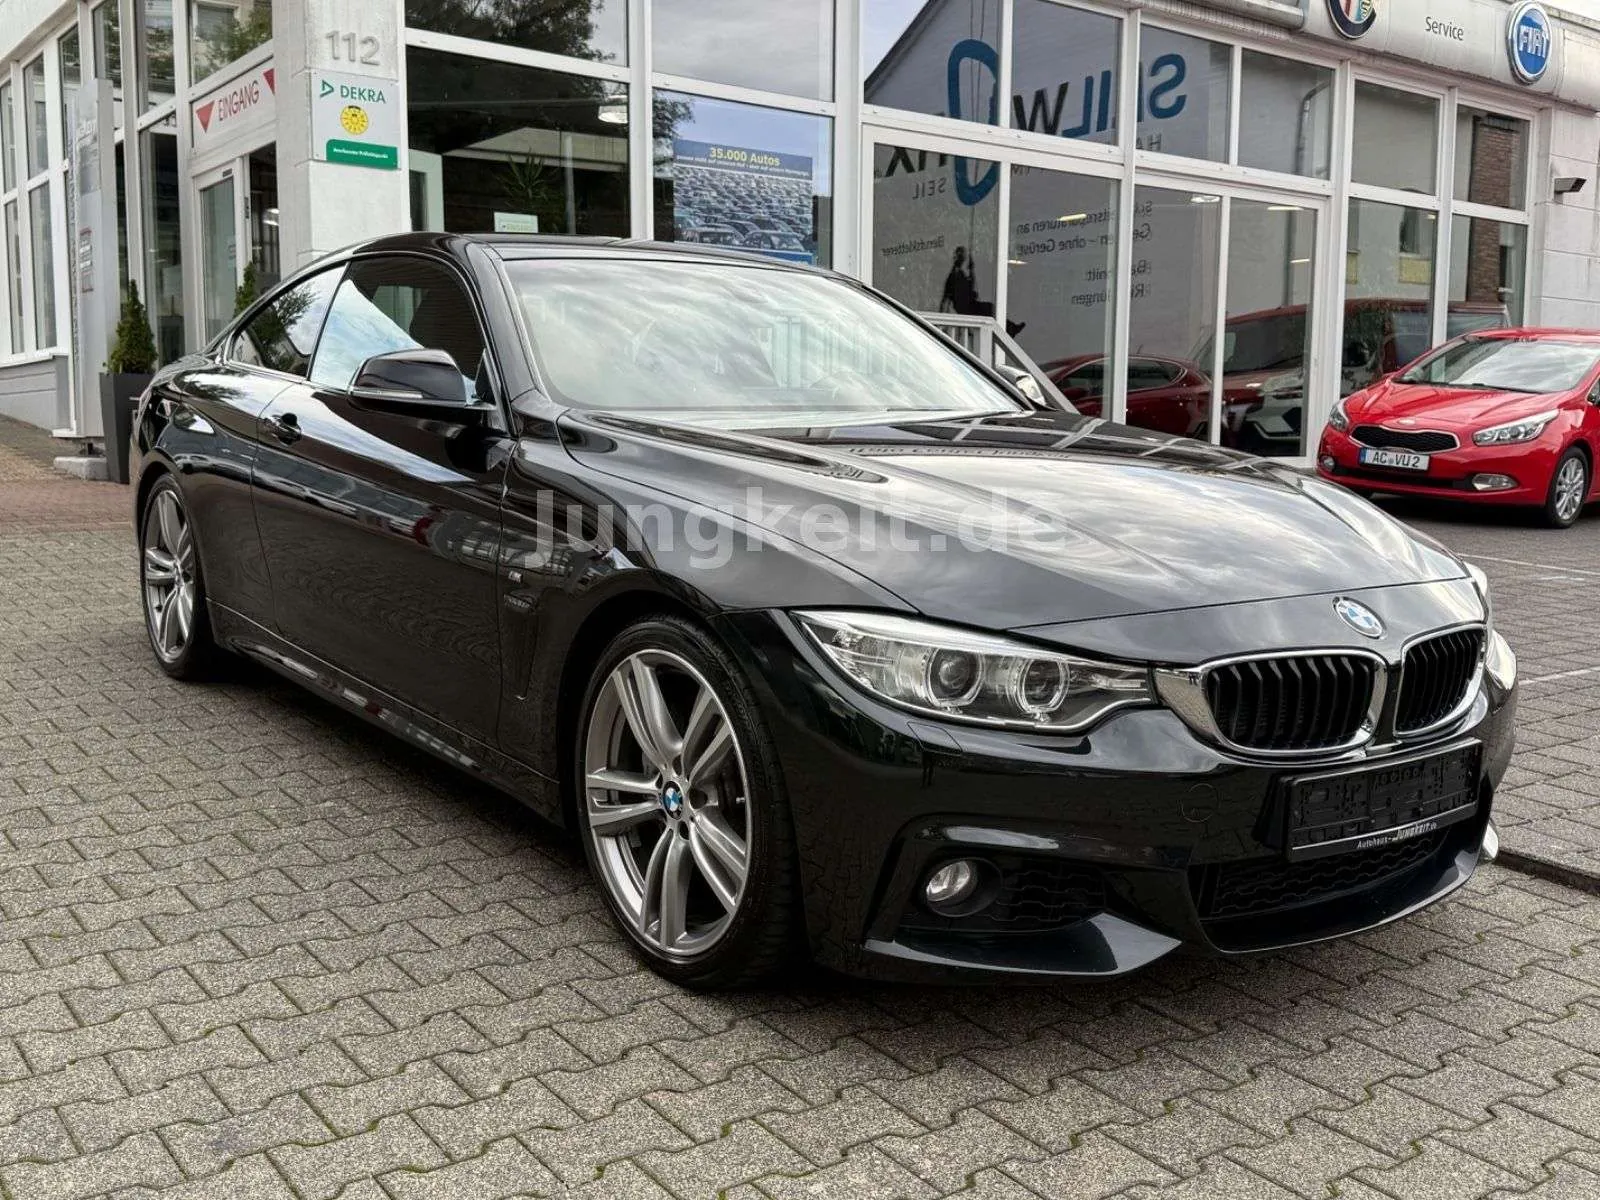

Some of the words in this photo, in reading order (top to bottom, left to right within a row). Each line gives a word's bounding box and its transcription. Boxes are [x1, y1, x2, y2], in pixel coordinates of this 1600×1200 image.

[1425, 16, 1464, 41] Service
[1519, 25, 1547, 57] FIAT
[325, 30, 380, 66] 112
[218, 80, 260, 121] EINGANG
[340, 85, 387, 104] DEKRA
[710, 147, 748, 162] 35.000
[750, 153, 781, 166] Autos
[1372, 451, 1387, 464] AC
